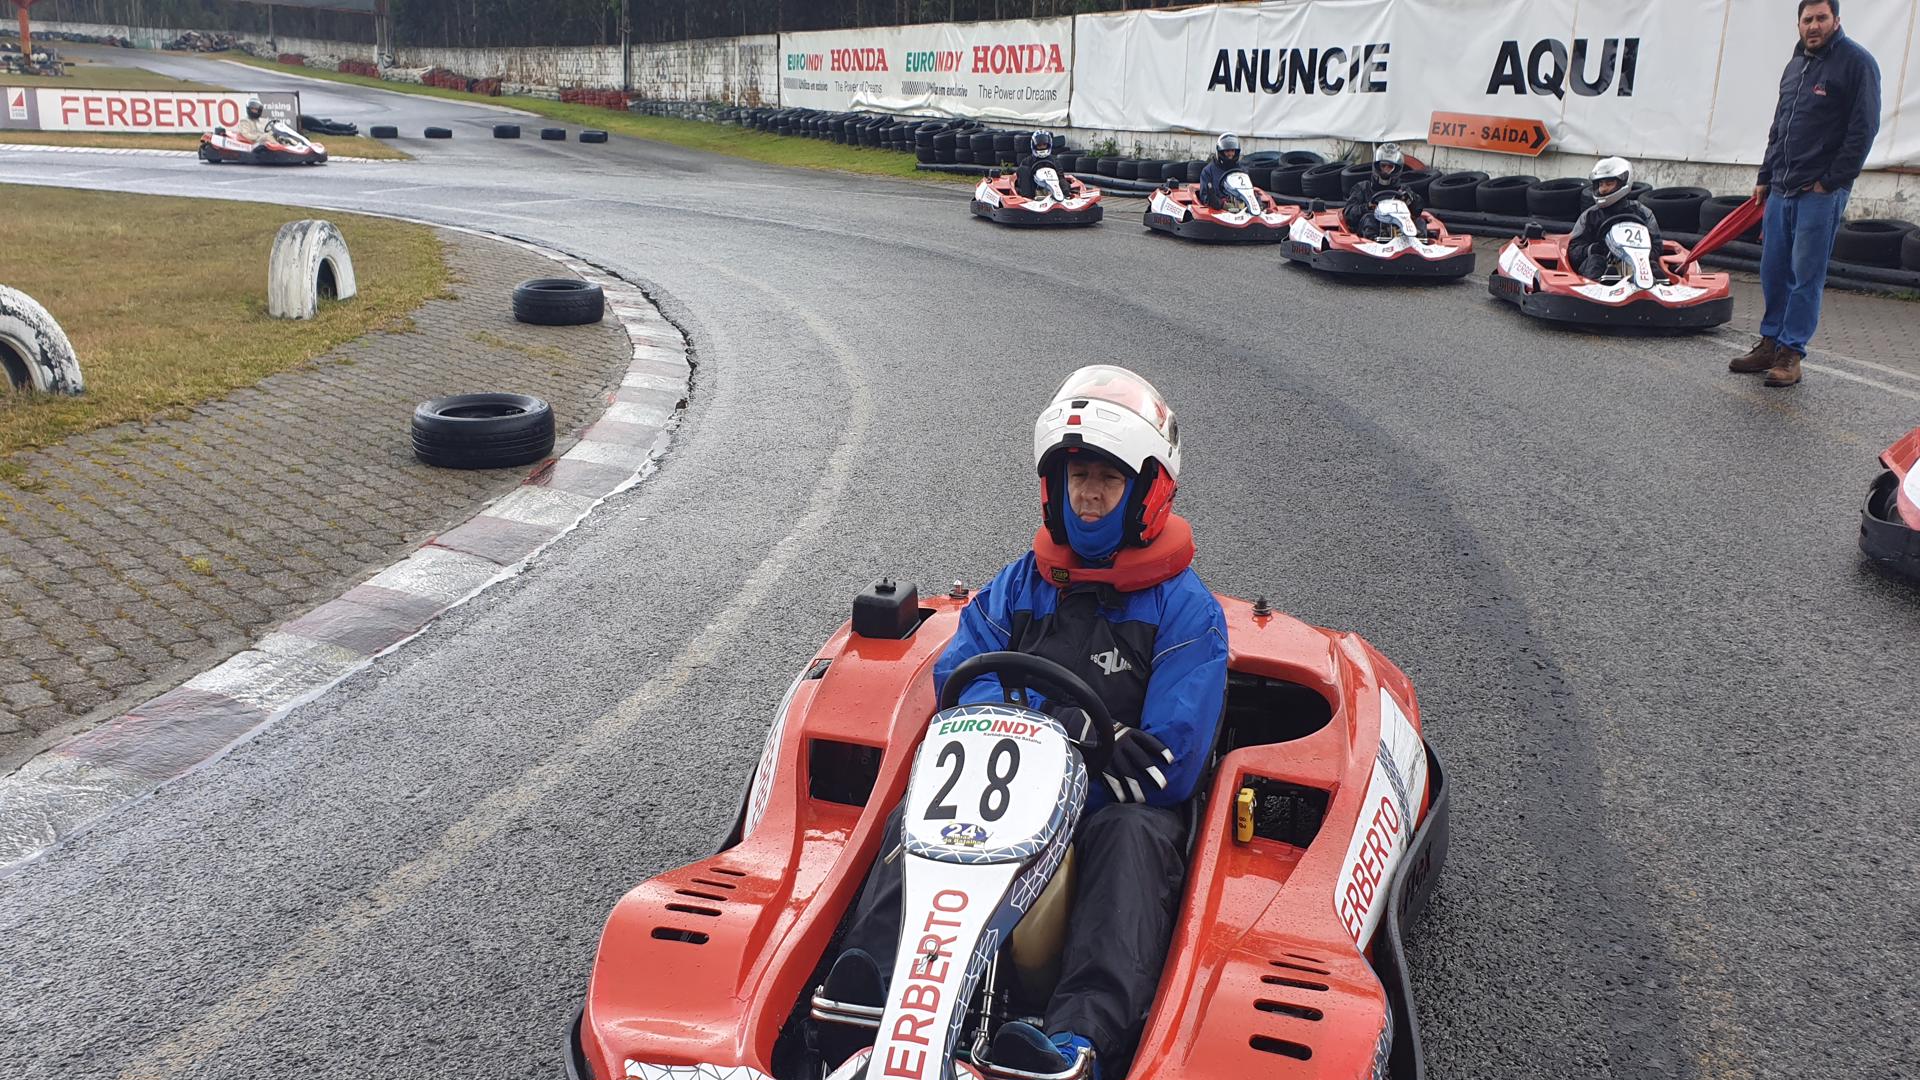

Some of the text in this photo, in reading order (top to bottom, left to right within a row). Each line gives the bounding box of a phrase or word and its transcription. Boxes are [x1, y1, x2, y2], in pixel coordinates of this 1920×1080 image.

[787, 54, 824, 71] EUROINDY
[830, 48, 889, 72] HONDA
[906, 51, 963, 72] EUROINDY
[971, 44, 1065, 74] HONDA
[1207, 38, 1640, 101] ANUNCIE AQUI
[979, 84, 1057, 101] The Power of Dreams
[60, 96, 240, 128] FERBERTO
[263, 101, 292, 111] raising
[271, 110, 285, 118] the
[1432, 122, 1467, 137] EXIT
[1481, 125, 1529, 144] SAÍDA
[1624, 228, 1643, 243] 24
[939, 719, 1042, 738] EUROINDY
[923, 738, 1021, 822] 28
[945, 823, 977, 838] 24
[1340, 796, 1399, 945] ERBERTO
